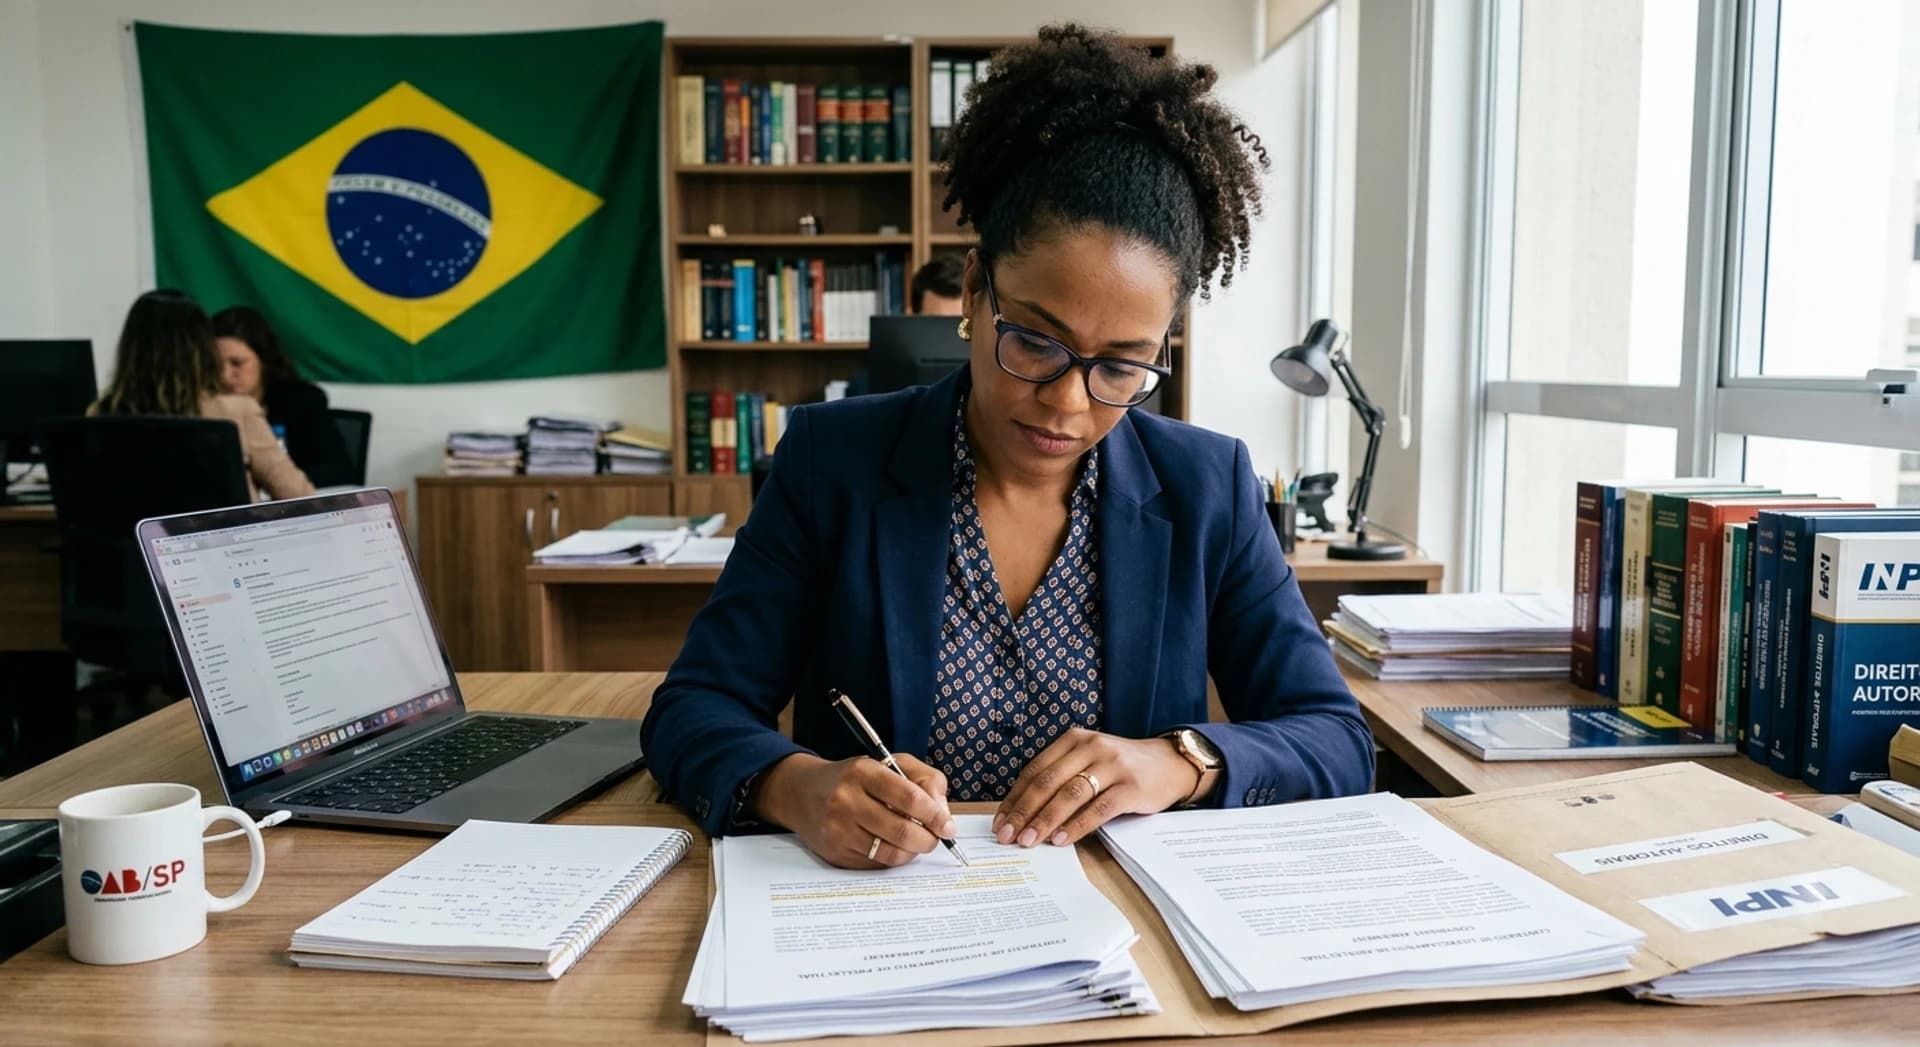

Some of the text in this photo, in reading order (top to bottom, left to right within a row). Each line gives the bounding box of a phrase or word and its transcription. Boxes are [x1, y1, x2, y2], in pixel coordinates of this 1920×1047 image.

[1854, 663, 1920, 680] DIREIT
[1853, 686, 1920, 702] AUTOR
[1709, 882, 1840, 917] INPI
